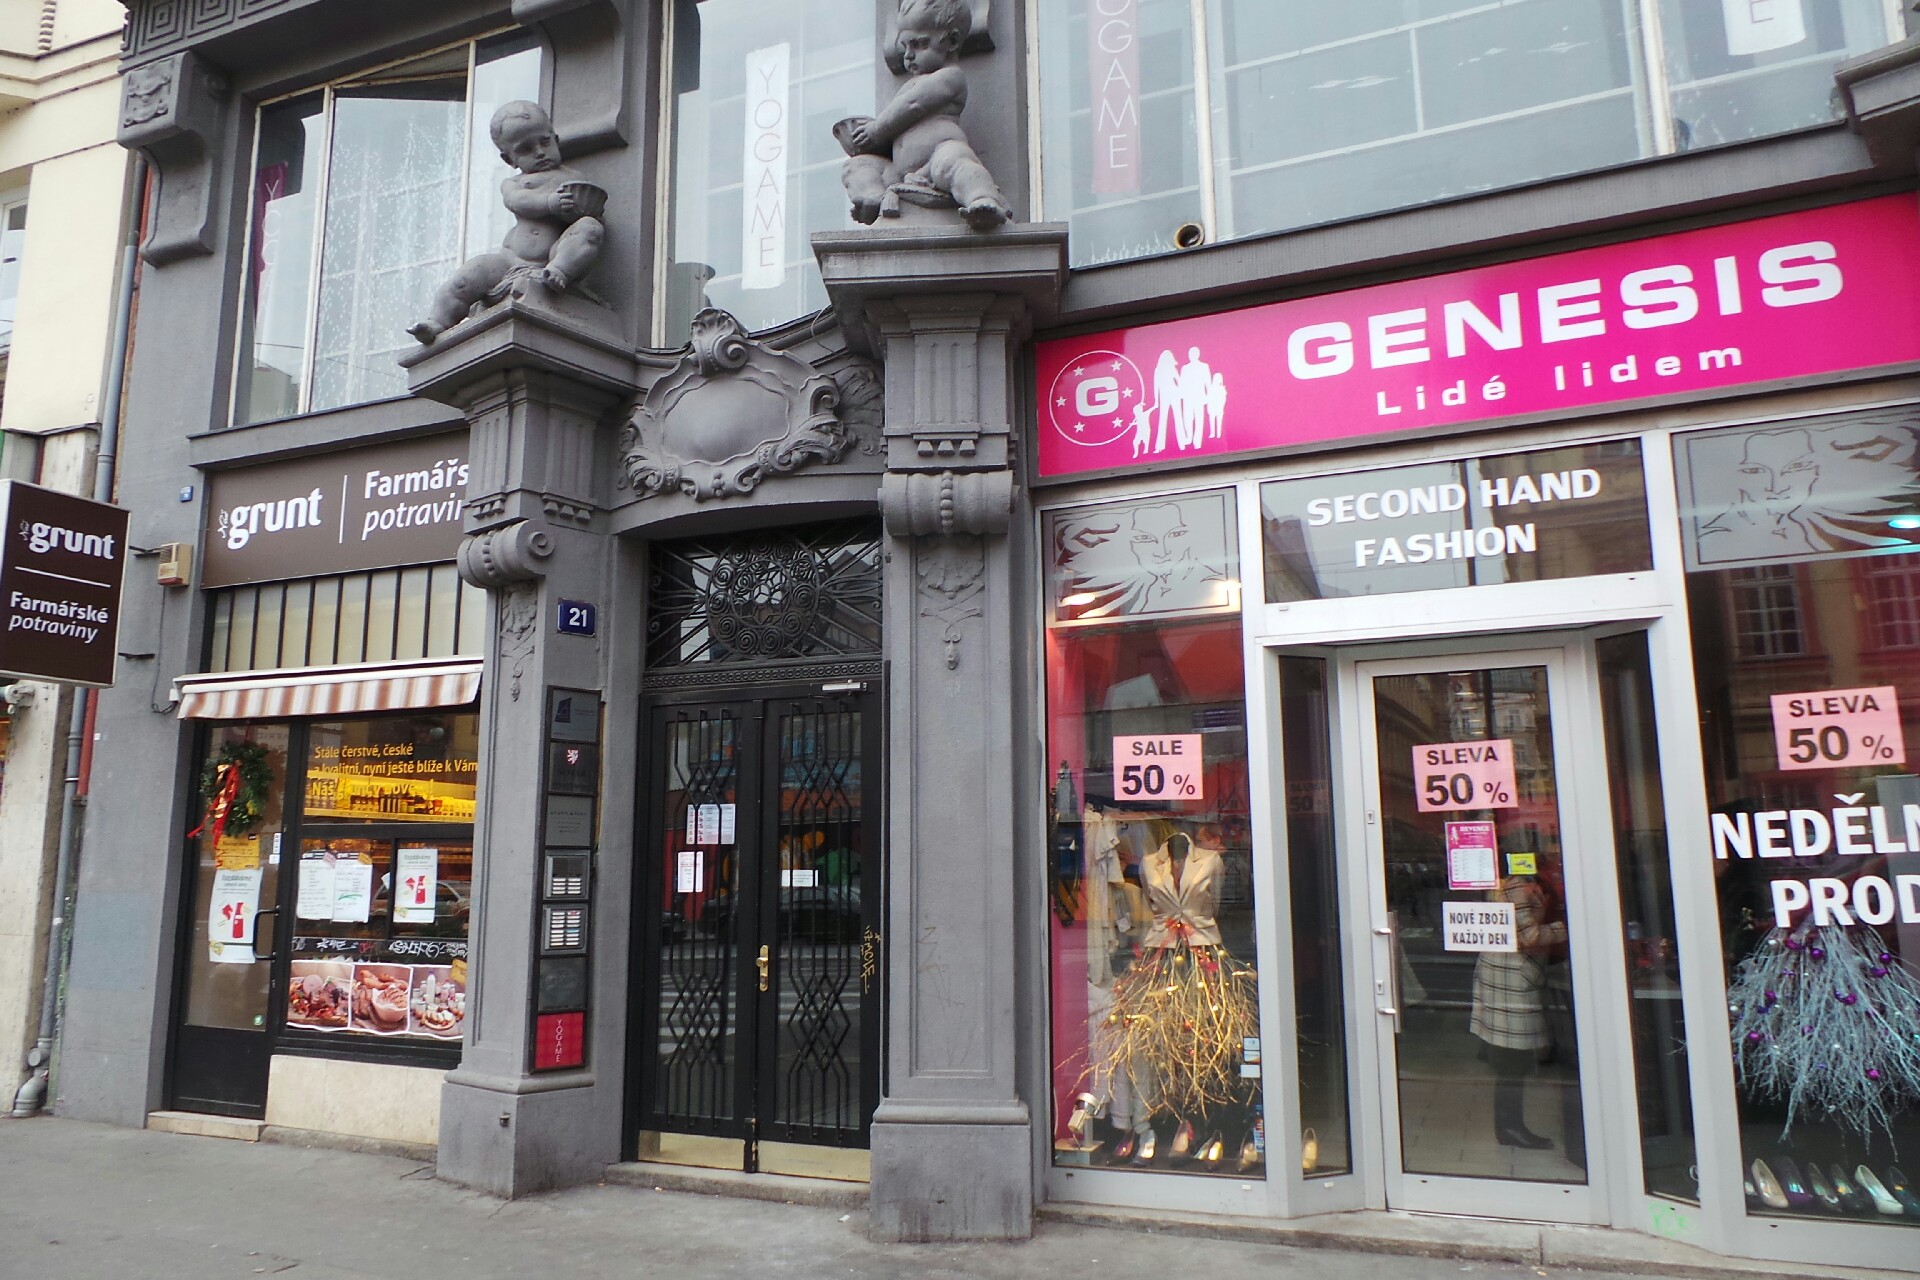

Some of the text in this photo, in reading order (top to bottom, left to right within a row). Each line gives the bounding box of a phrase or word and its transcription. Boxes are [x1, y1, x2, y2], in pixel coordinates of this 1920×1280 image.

[751, 64, 783, 267] YOGAME
[1287, 240, 1843, 381] GENESIS
[1076, 376, 1119, 417] G
[1376, 347, 1742, 415] Lidé lidem
[1307, 469, 1601, 526] SECOND HAND
[227, 488, 323, 549] grunt
[29, 522, 115, 559] grunt
[1355, 523, 1537, 567] FASHION
[10, 591, 109, 623] Farmářské
[569, 607, 588, 627] 21
[8, 615, 98, 643] potraviny
[1789, 694, 1880, 718] SLEVA
[314, 743, 413, 758] Stále čerstvé, české
[1132, 740, 1183, 756] SALE
[1427, 746, 1498, 766] SLEVA
[1789, 725, 1893, 763] 50 %
[363, 761, 386, 777] nyní
[387, 760, 414, 776] ještě
[416, 759, 442, 773] blíže
[445, 760, 452, 772] k
[1122, 765, 1195, 795] 50 %
[1426, 773, 1508, 806] 50 %
[1450, 909, 1509, 925] NOVÉ ZBOŽÍ
[1452, 930, 1508, 945] KAŽDÝ DEN
[555, 1019, 563, 1063] YOGAME
